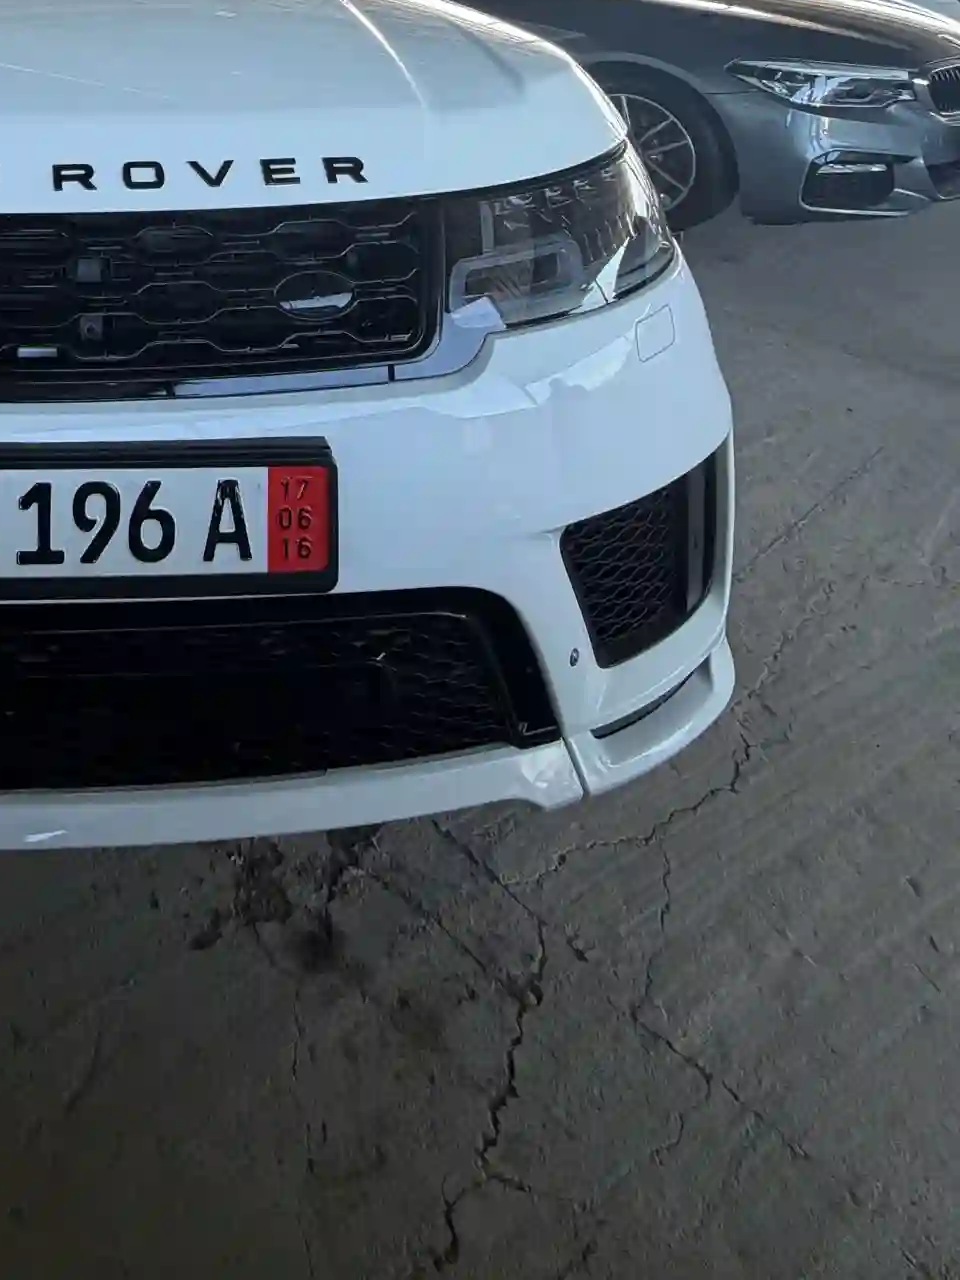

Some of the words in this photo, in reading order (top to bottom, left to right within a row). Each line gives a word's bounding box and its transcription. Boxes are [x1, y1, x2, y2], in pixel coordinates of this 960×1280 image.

[51, 156, 369, 192] ROVER
[280, 476, 313, 501] 17
[16, 479, 177, 566] 196
[203, 478, 253, 562] A
[279, 505, 313, 530] 06
[282, 536, 313, 560] 16
